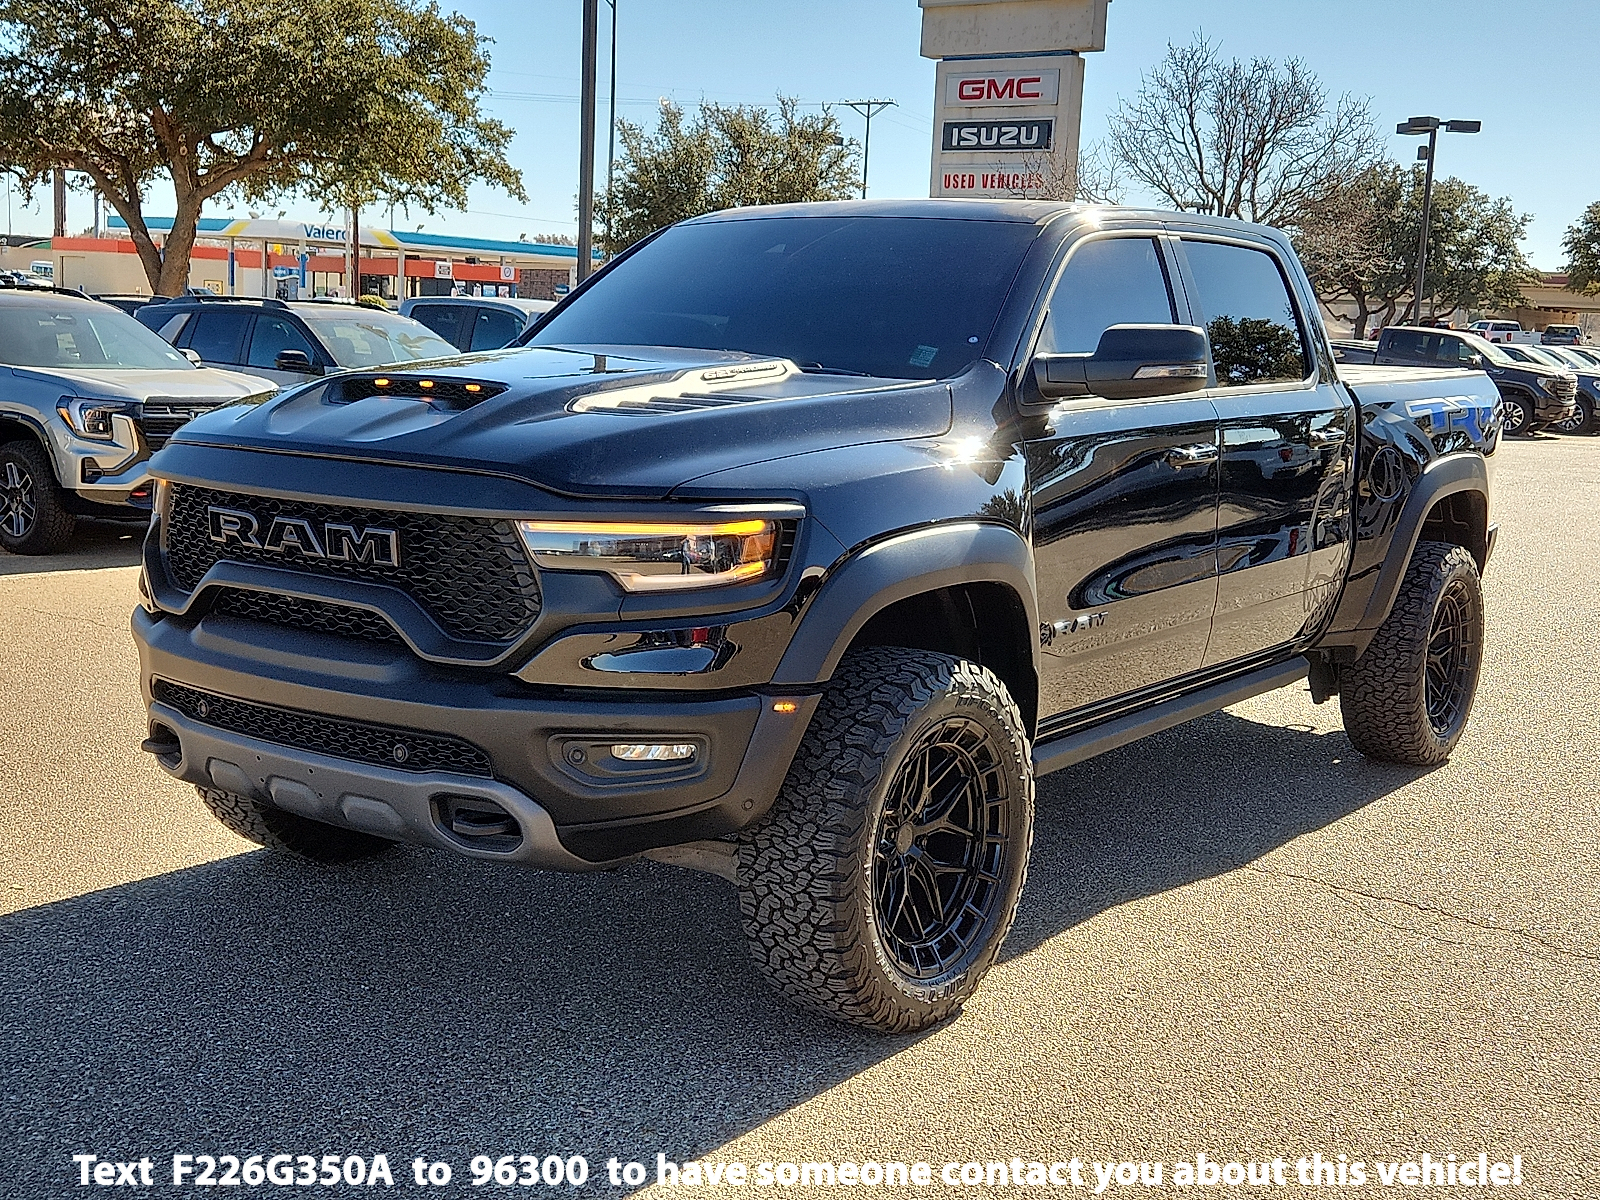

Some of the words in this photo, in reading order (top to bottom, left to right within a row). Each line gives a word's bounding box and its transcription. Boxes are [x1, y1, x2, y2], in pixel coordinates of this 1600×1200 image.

[958, 77, 1041, 100] GMC
[951, 126, 1039, 146] ISUZU
[943, 173, 975, 189] USED
[981, 173, 1044, 190] VEHICLES
[208, 505, 399, 567] RAM
[1053, 610, 1109, 639] RAM
